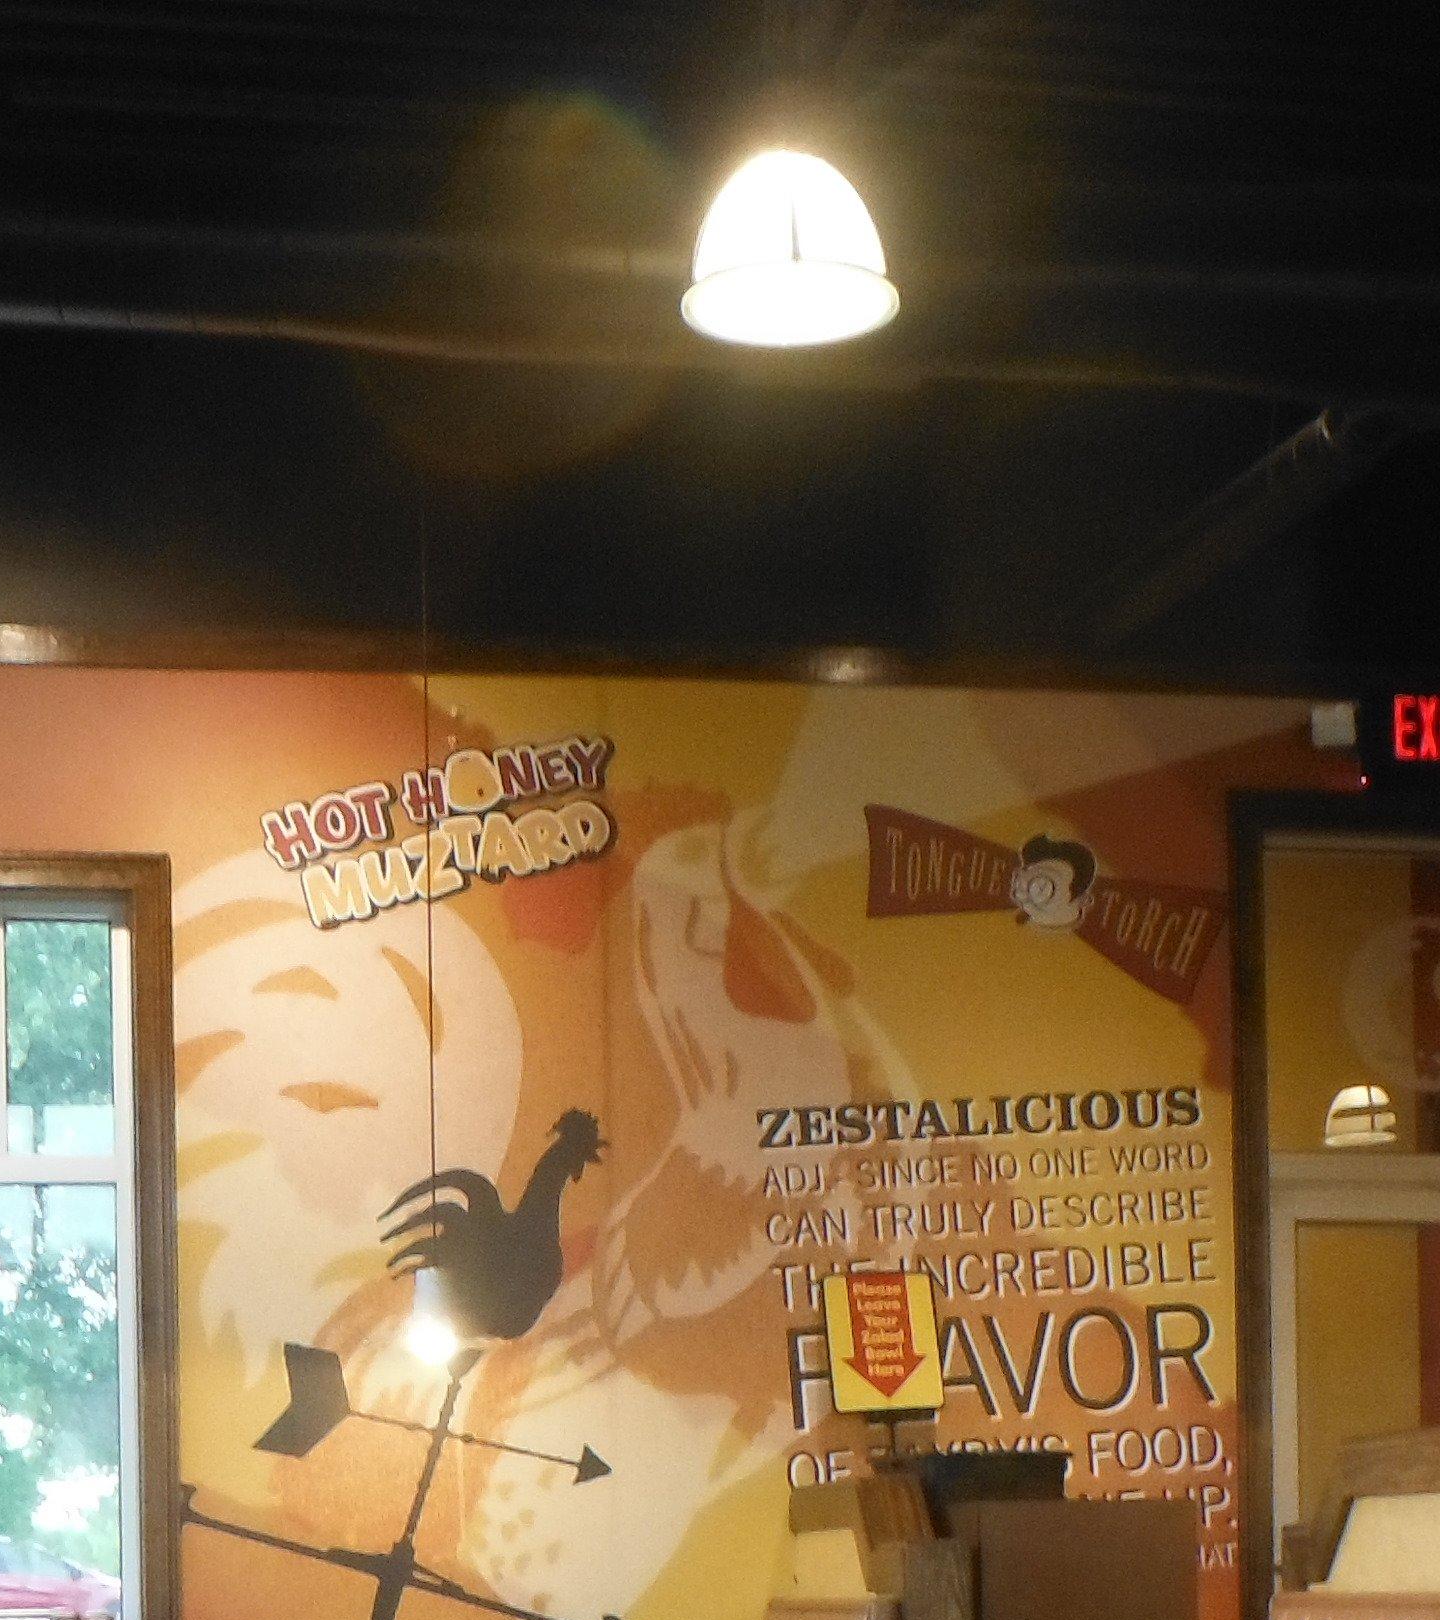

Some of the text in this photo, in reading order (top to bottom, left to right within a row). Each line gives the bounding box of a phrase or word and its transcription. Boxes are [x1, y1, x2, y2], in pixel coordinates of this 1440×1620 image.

[260, 736, 612, 868] HOT HONEY
[301, 801, 615, 929] MUZTARD
[886, 827, 1208, 977] TONGUE TORCH
[756, 1086, 1203, 1149] ZESTALICIOUS
[858, 1154, 960, 1191] SINCE
[972, 1152, 1022, 1185] NO
[1029, 1147, 1100, 1182] ONE
[1109, 1140, 1212, 1176] WORD
[766, 1185, 1216, 1249] CAN TRULY DESCRIBE
[788, 1302, 1223, 1433] FAVOR
[788, 1449, 856, 1487] OF
[1087, 1424, 1234, 1479] FOOD,
